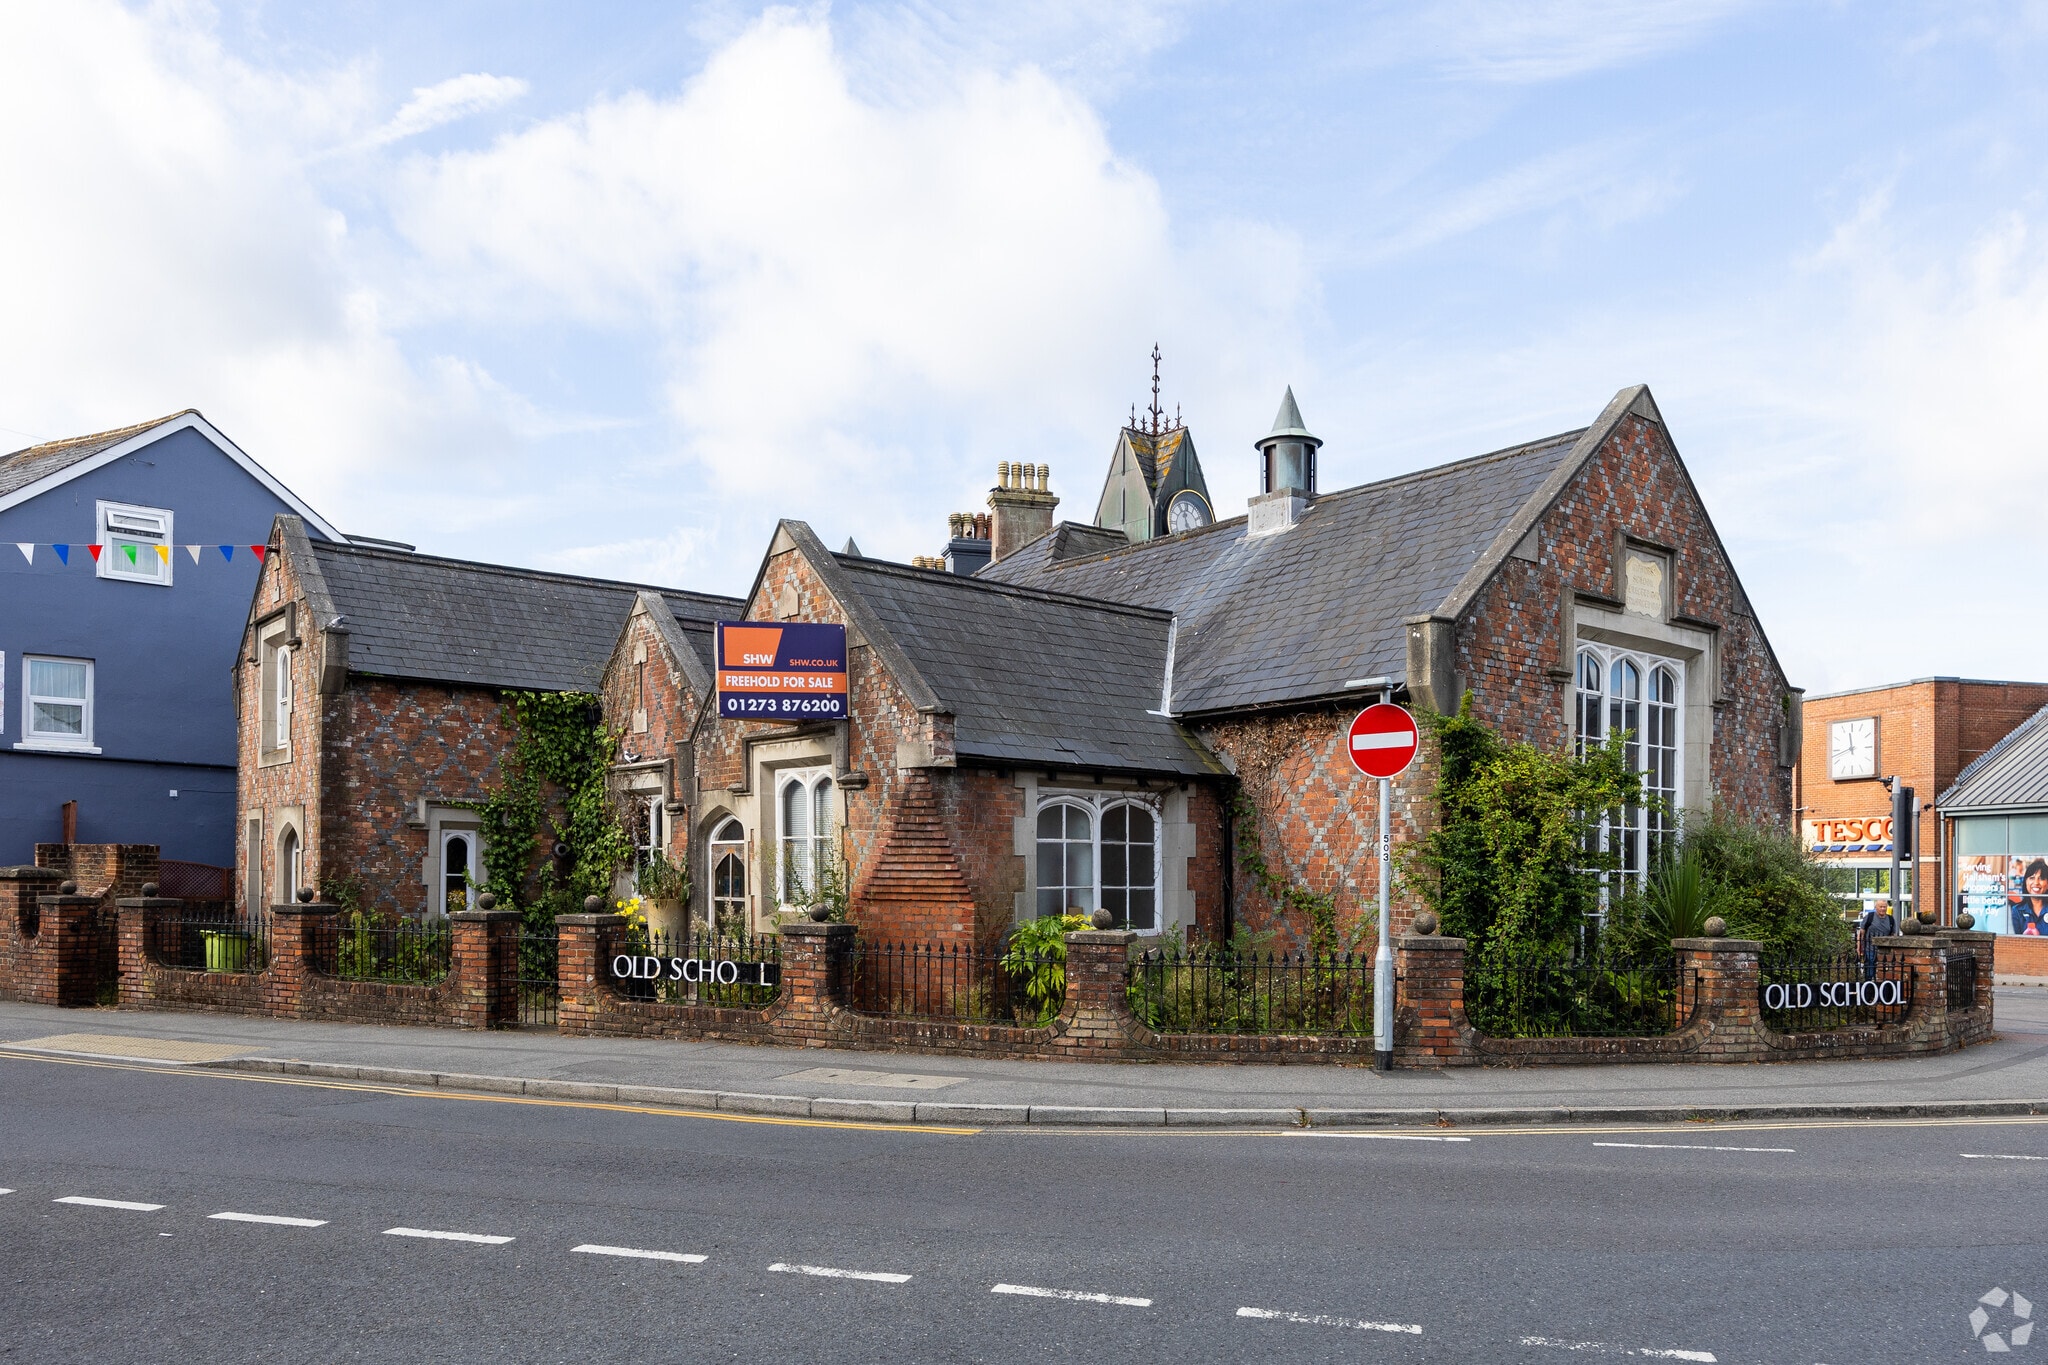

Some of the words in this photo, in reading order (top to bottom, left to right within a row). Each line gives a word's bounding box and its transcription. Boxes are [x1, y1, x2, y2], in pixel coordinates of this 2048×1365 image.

[743, 653, 773, 665] SHW
[789, 658, 838, 667] SHW.CO.UK
[725, 675, 780, 687] FREEHOLD
[783, 677, 805, 688] FOR
[808, 677, 833, 688] SALE
[727, 698, 777, 711] 01273
[782, 699, 840, 712] 876200
[1811, 818, 1893, 842] TESCO
[1963, 863, 1991, 872] Serving
[1962, 895, 1980, 904] little
[1981, 895, 2006, 904] better
[1962, 907, 1984, 916] every
[1986, 907, 1999, 916] day
[613, 955, 661, 979] OLD
[1765, 983, 1812, 1009] OLD
[1820, 980, 1907, 1007] SCHOOL
